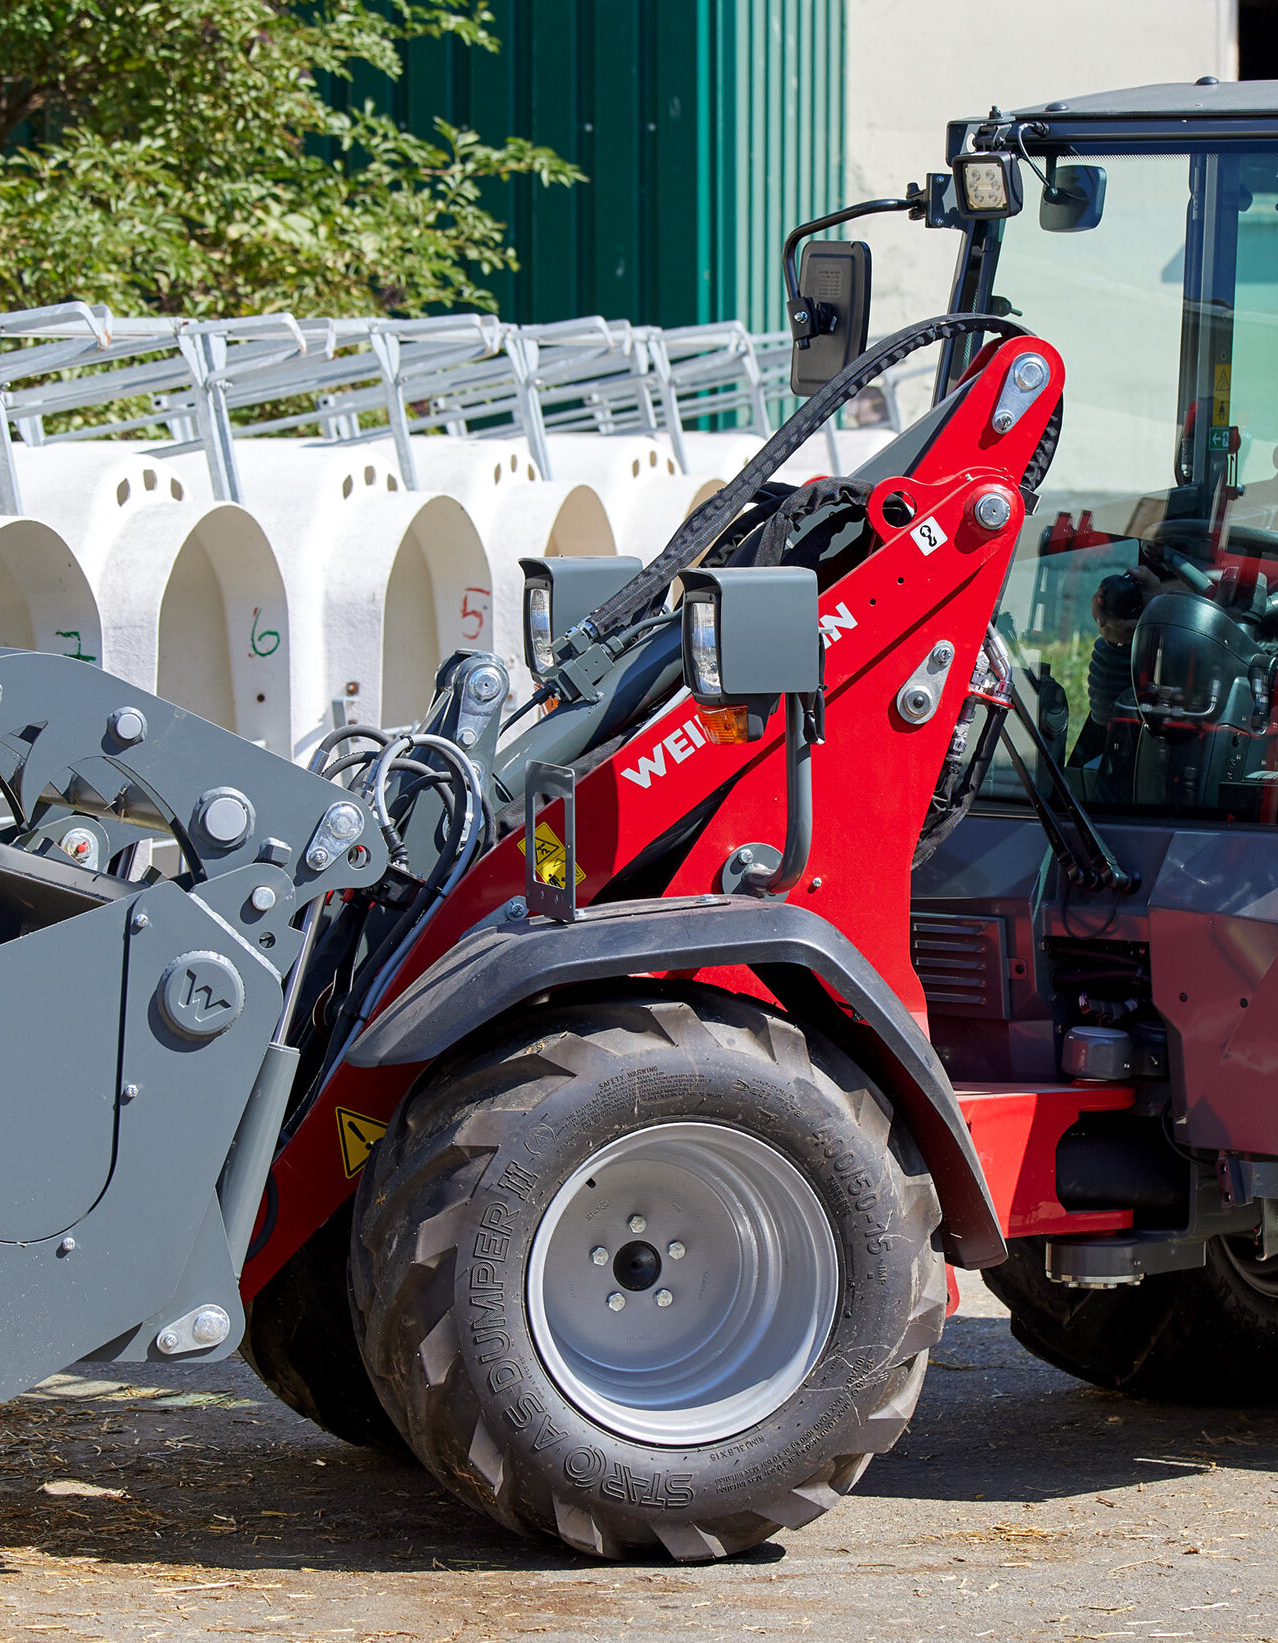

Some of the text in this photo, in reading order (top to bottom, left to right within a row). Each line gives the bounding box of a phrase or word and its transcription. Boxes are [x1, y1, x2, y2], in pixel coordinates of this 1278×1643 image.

[249, 607, 280, 657] 6
[461, 587, 490, 640] 5
[598, 1064, 658, 1089] SAFETY WARNING
[810, 1124, 894, 1256] 400/50-15
[470, 1202, 524, 1394] DUMPER
[505, 1390, 570, 1453] AS
[811, 1410, 832, 1431] LOAD
[828, 1393, 845, 1413] MAX
[563, 1444, 694, 1508] STARCO
